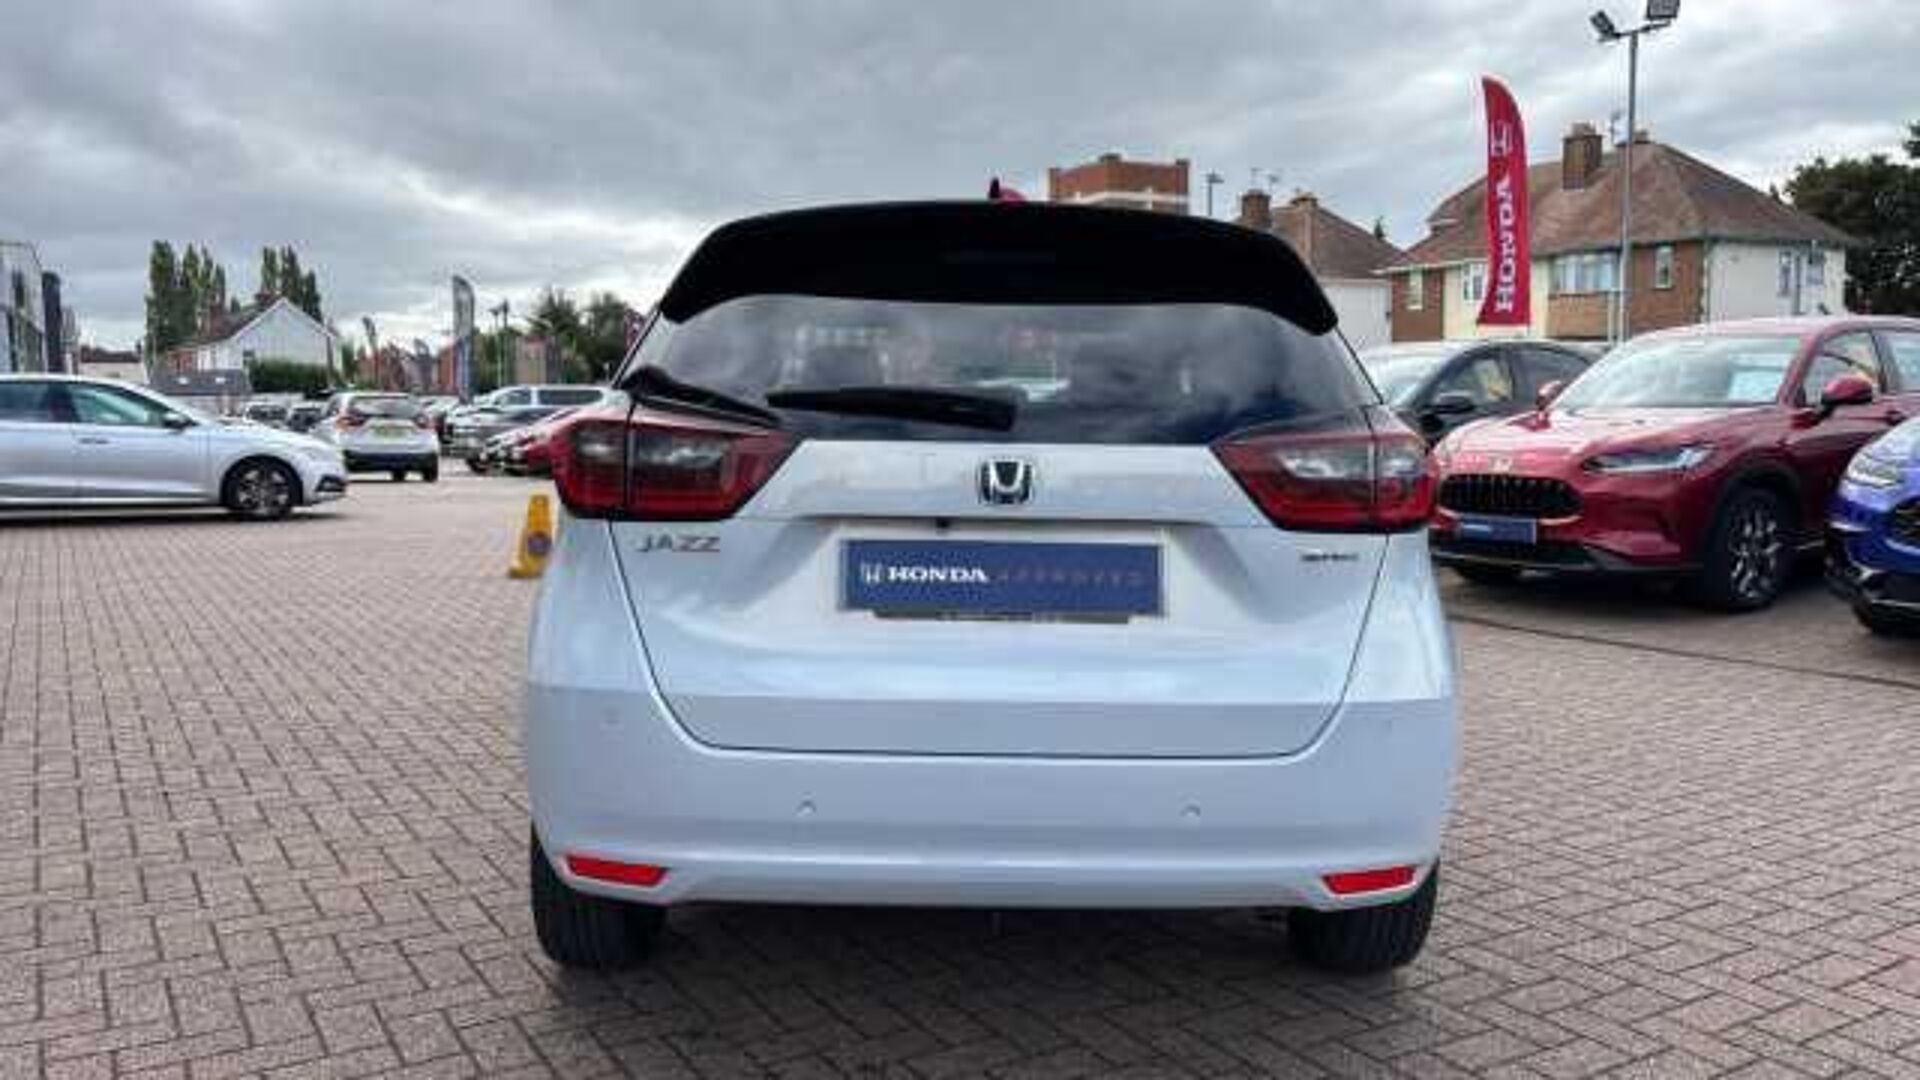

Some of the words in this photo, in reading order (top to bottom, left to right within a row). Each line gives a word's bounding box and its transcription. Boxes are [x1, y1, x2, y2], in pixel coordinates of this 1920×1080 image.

[1493, 176, 1517, 312] HONDA
[635, 533, 721, 553] JAZZ
[887, 565, 990, 583] HONDA
